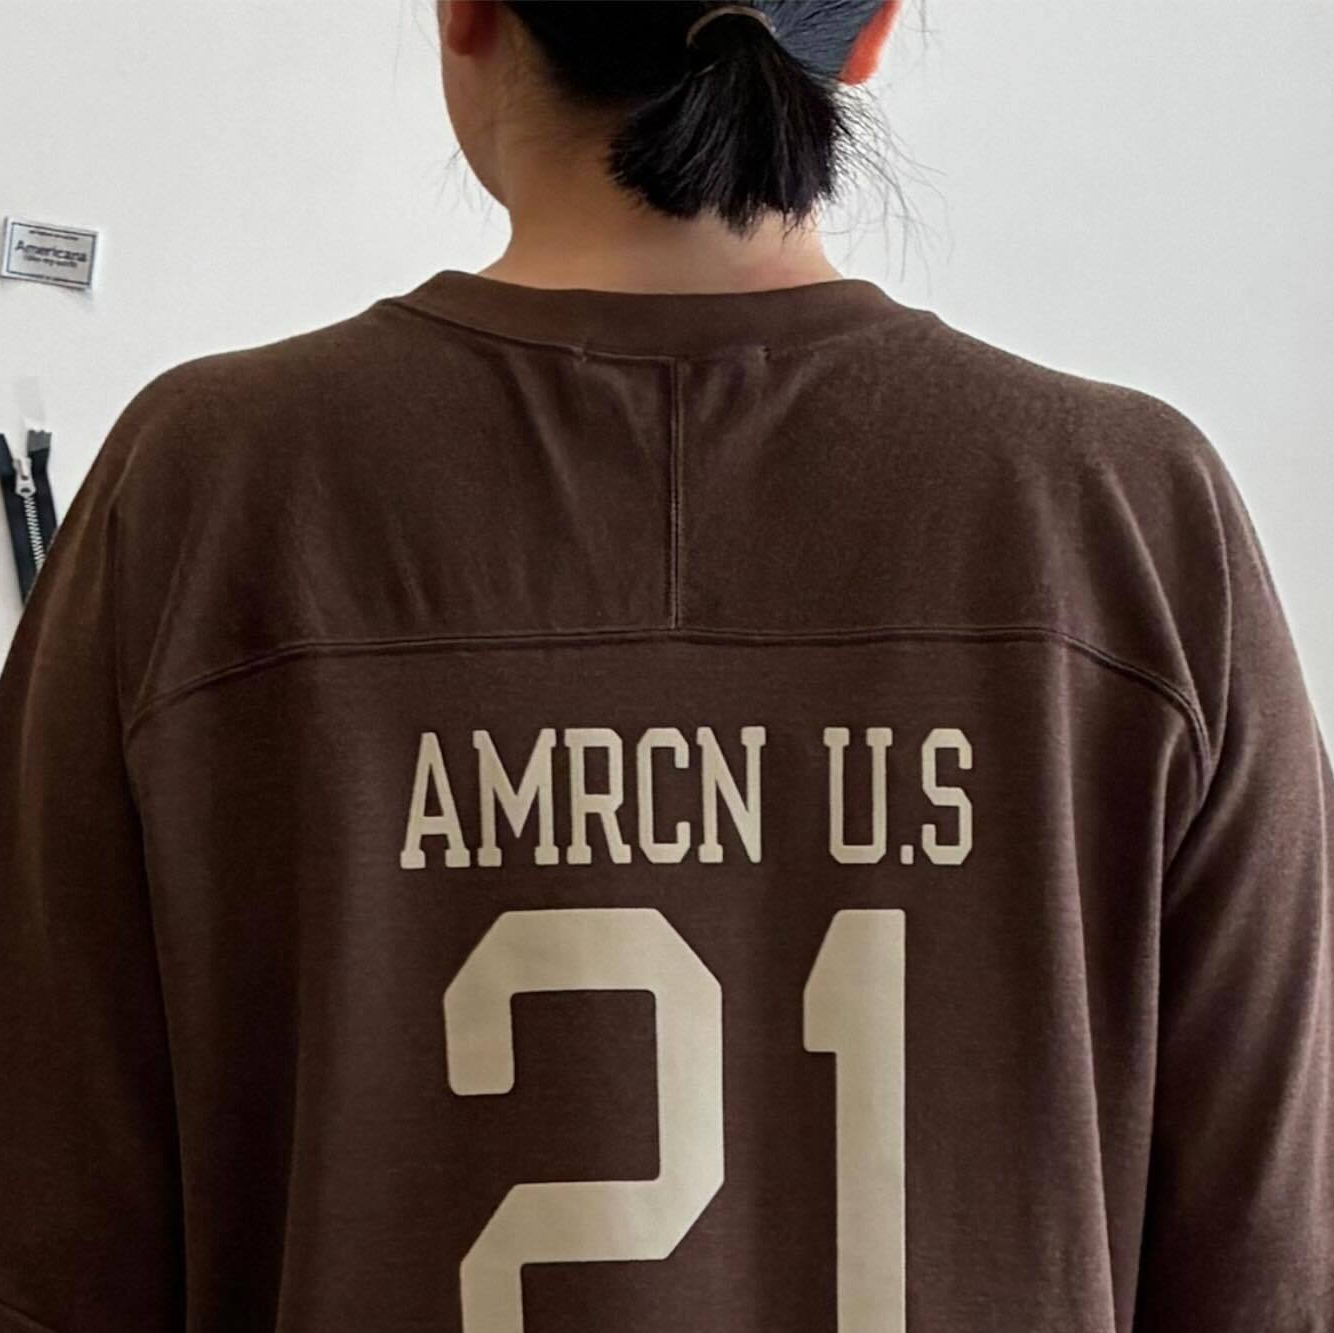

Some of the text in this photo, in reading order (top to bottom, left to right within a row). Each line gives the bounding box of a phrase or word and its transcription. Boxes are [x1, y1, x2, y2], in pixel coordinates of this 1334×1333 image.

[14, 239, 88, 263] Americana
[400, 724, 974, 869] AMRCN U.S
